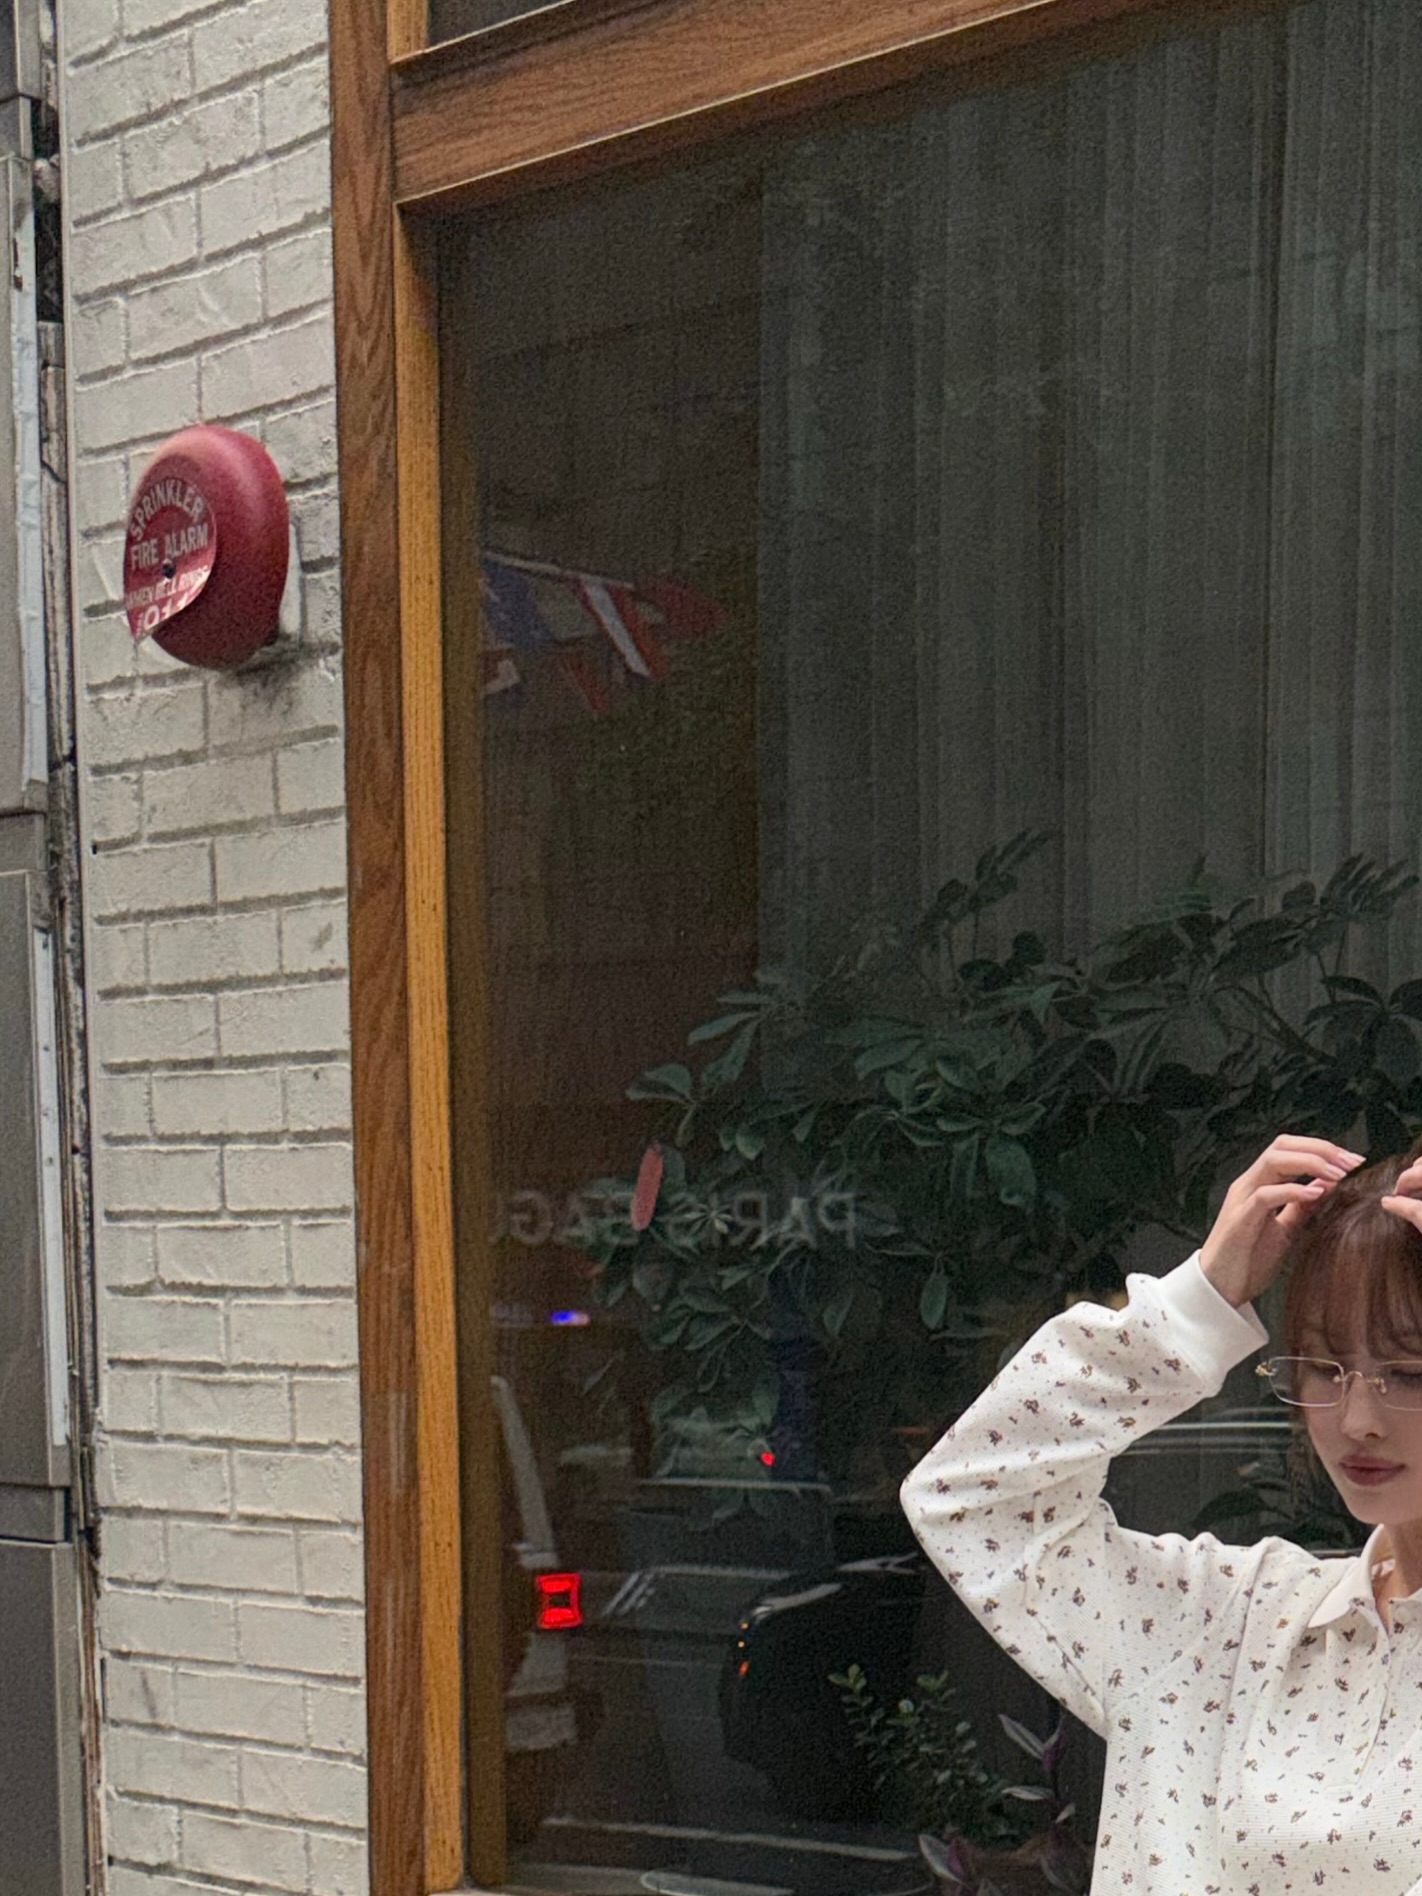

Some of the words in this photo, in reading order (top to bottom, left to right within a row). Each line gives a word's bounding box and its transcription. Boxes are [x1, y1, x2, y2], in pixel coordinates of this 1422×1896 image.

[129, 478, 205, 541] SPRINKLER
[130, 538, 160, 571] FIRE
[164, 522, 209, 558] ALARM
